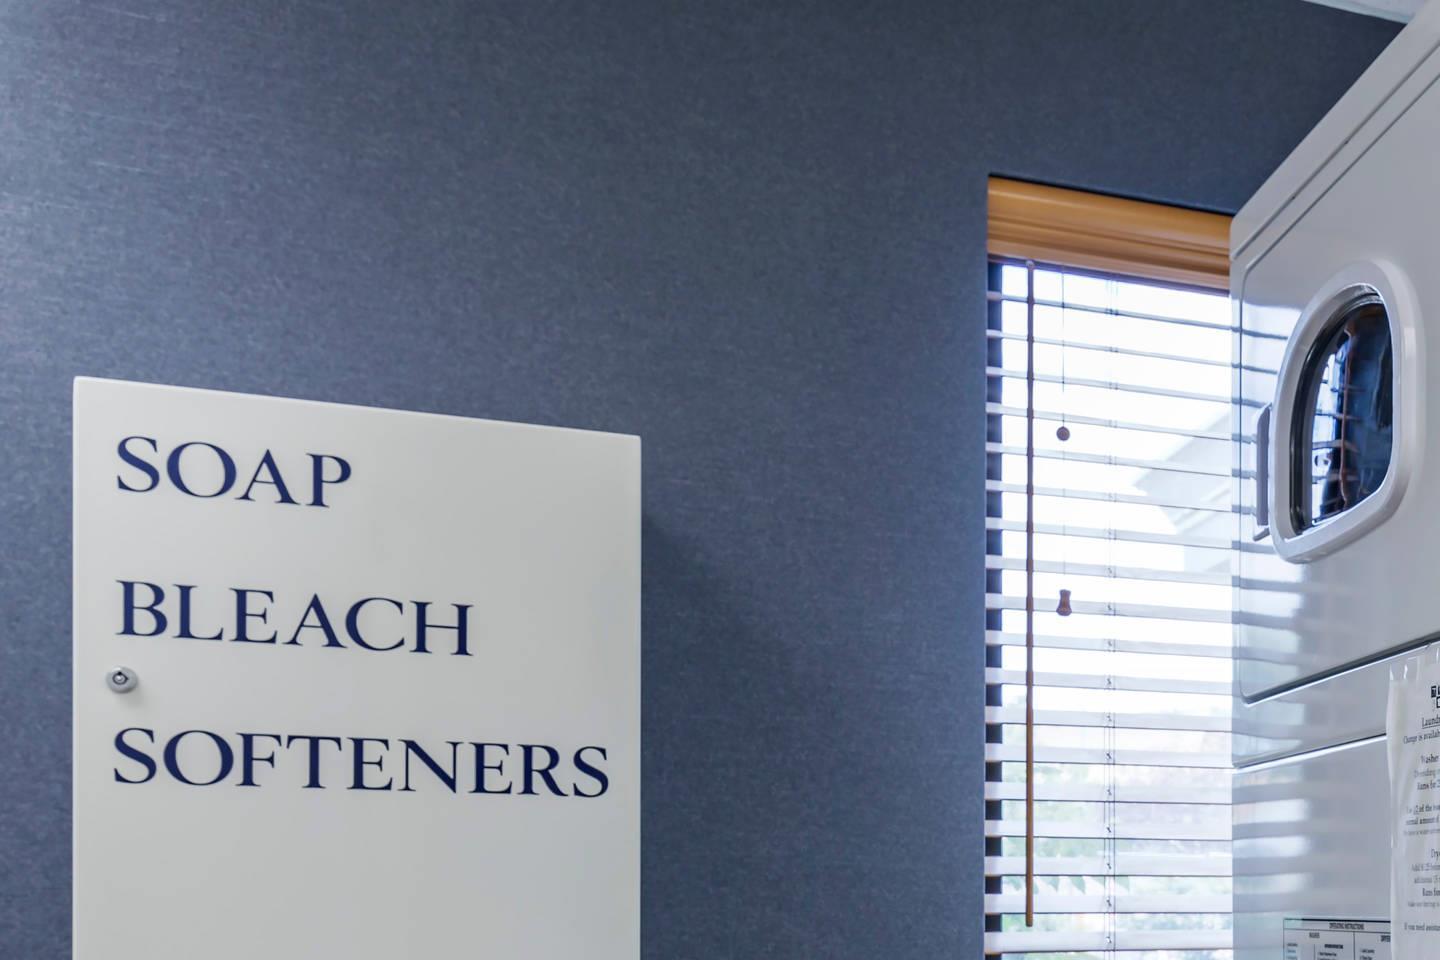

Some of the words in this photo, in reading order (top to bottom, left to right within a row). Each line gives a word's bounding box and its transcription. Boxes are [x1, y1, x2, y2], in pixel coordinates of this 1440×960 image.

[116, 436, 352, 508] SOAP
[115, 580, 474, 656] BLEACH
[113, 727, 609, 798] SOFTENERS
